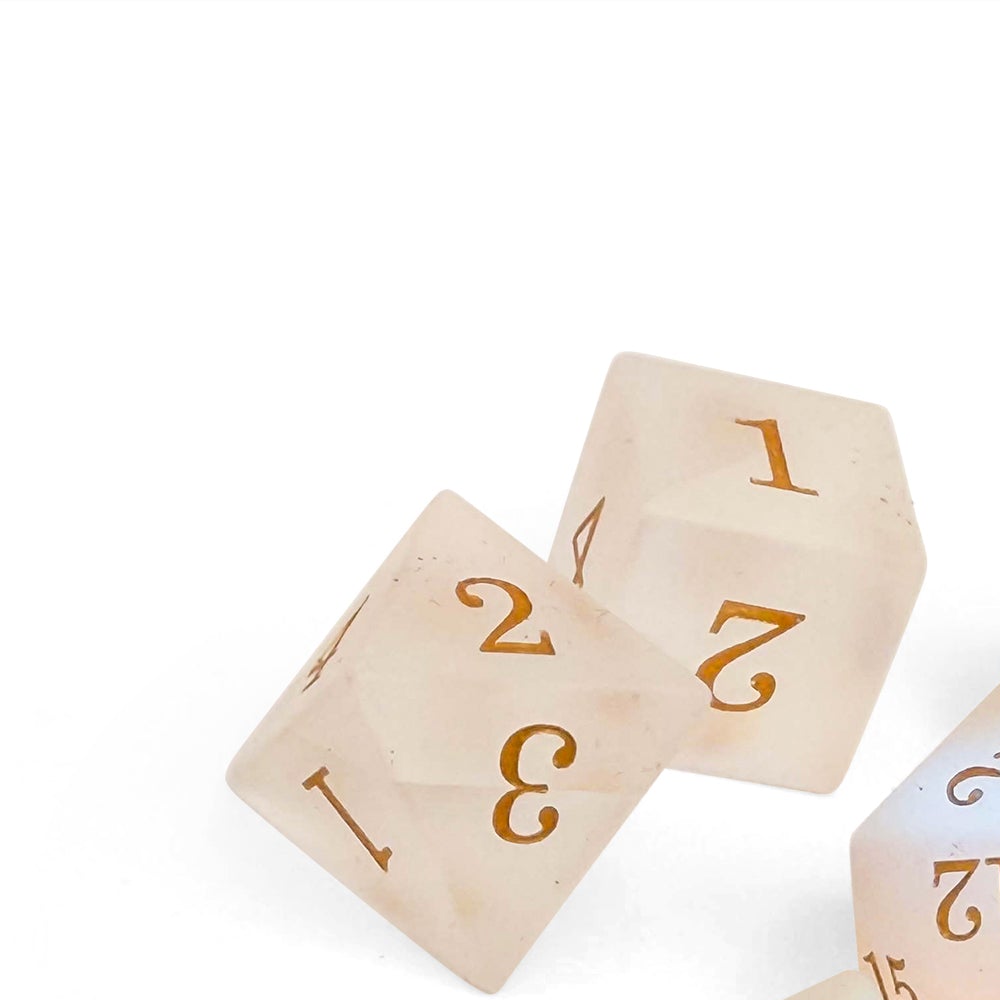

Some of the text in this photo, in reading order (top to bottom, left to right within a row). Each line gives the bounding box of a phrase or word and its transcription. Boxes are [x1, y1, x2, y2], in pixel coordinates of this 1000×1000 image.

[735, 419, 819, 497] 1
[455, 577, 556, 656] 2
[695, 600, 806, 712] 2
[302, 766, 392, 872] 1
[492, 724, 577, 844] 3
